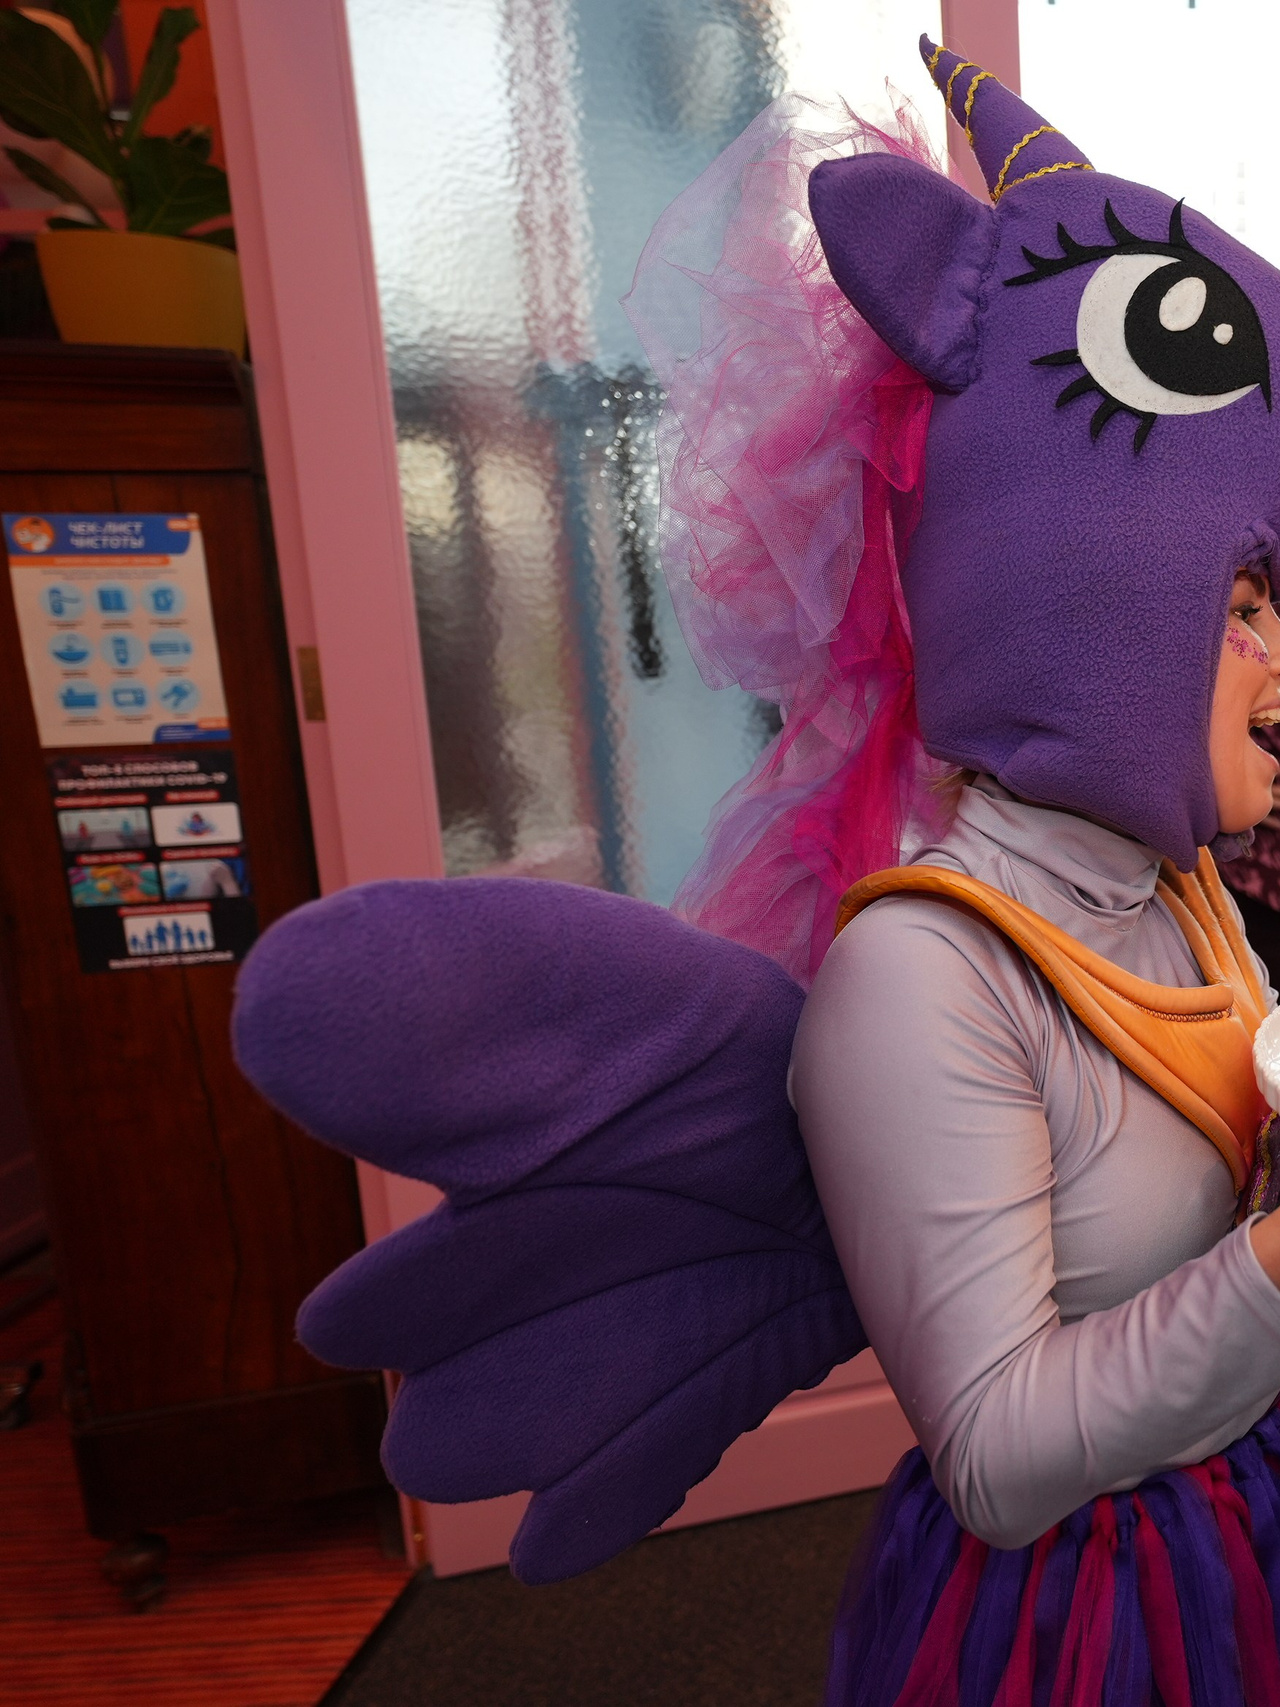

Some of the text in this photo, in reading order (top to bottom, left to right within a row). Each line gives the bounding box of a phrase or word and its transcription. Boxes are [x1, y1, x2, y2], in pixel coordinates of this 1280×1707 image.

[68, 521, 143, 535] ЧЕК-ЛИСТ
[70, 536, 145, 549] ЧИСТОТЫ
[124, 760, 199, 775] СПОСОБОВ
[166, 771, 228, 786] COVID-19
